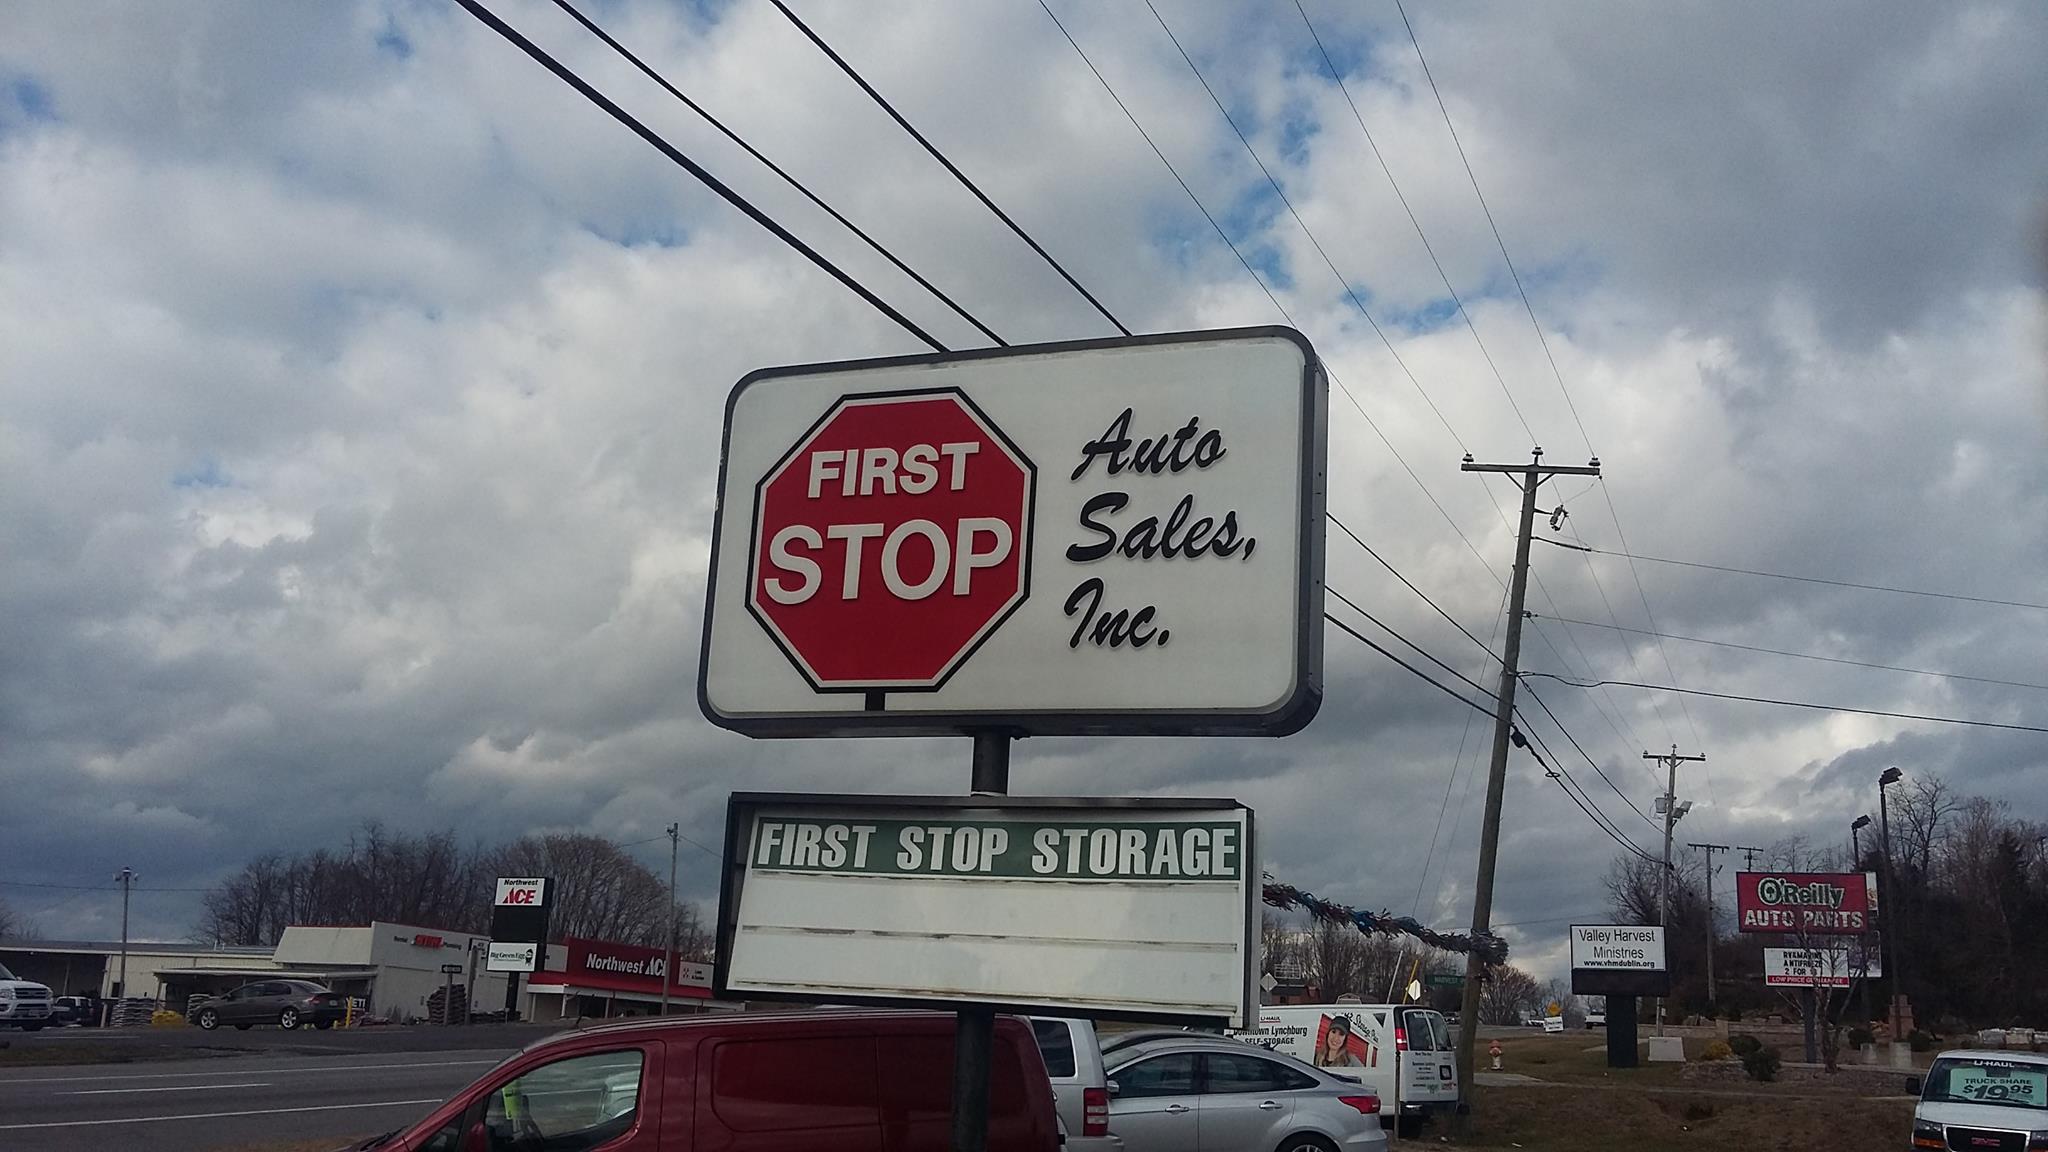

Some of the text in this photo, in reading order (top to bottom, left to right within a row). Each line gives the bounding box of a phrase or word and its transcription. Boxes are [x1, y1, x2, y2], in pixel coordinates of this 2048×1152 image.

[1070, 407, 1227, 481] Auto
[807, 441, 980, 498] FIRST
[1066, 492, 1257, 562] Sales,
[763, 517, 1013, 605] STOP
[1063, 577, 1171, 649] Inc.
[758, 823, 1236, 877] FIRST STOP STORAGE
[502, 887, 537, 904] ACE
[1758, 877, 1845, 909] O'Reilly
[1744, 910, 1864, 928] AUTO PARTS
[1579, 929, 1655, 944] Valley Harvest
[1593, 946, 1644, 959] Ministries
[586, 953, 644, 974] Northwest
[1584, 960, 1655, 968] www.vhmdublin.org
[1245, 1037, 1295, 1045] SELF-STORAGE
[1271, 1025, 1308, 1037] Lynchburg
